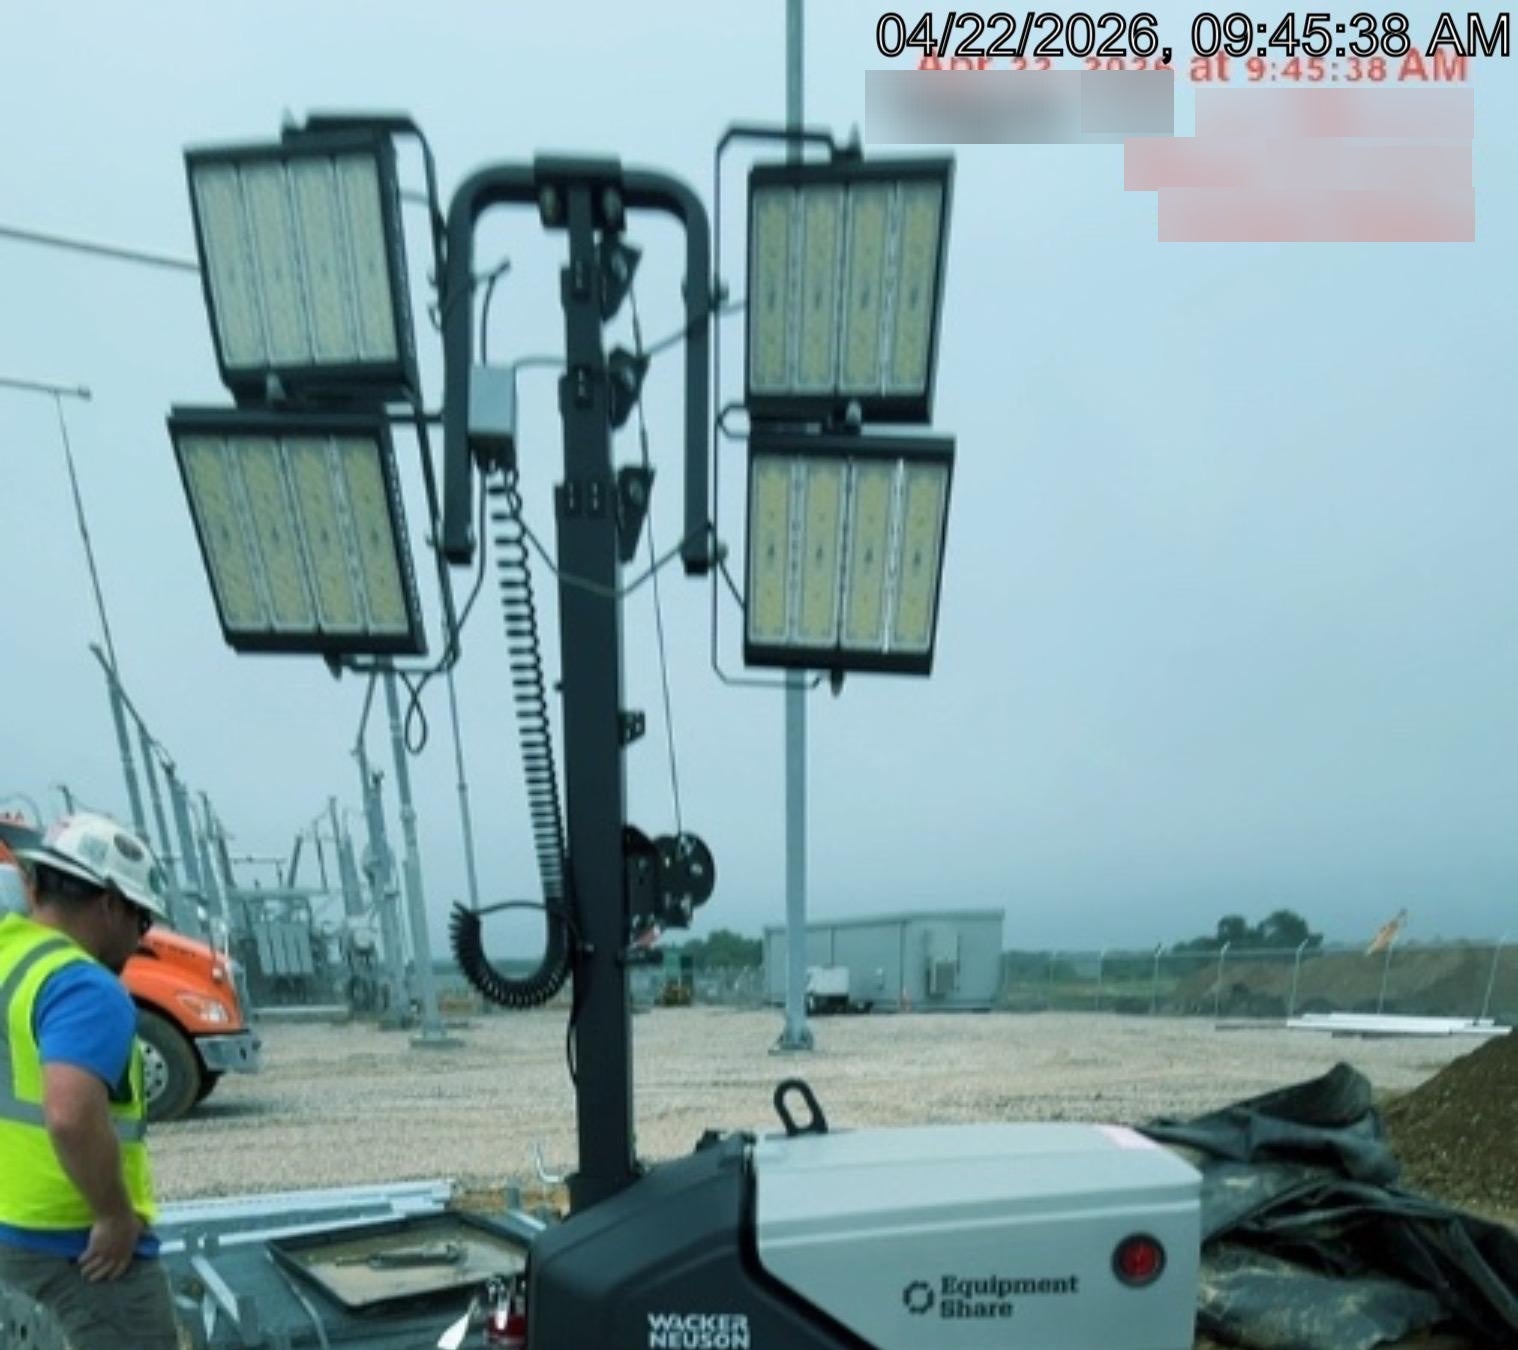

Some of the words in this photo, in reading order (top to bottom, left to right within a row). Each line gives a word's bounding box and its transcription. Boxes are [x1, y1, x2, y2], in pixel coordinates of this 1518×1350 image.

[941, 1275, 1079, 1299] Equipment
[941, 1300, 1013, 1318] Share
[647, 1313, 748, 1331] WACKER
[649, 1332, 751, 1350] NEUSON
